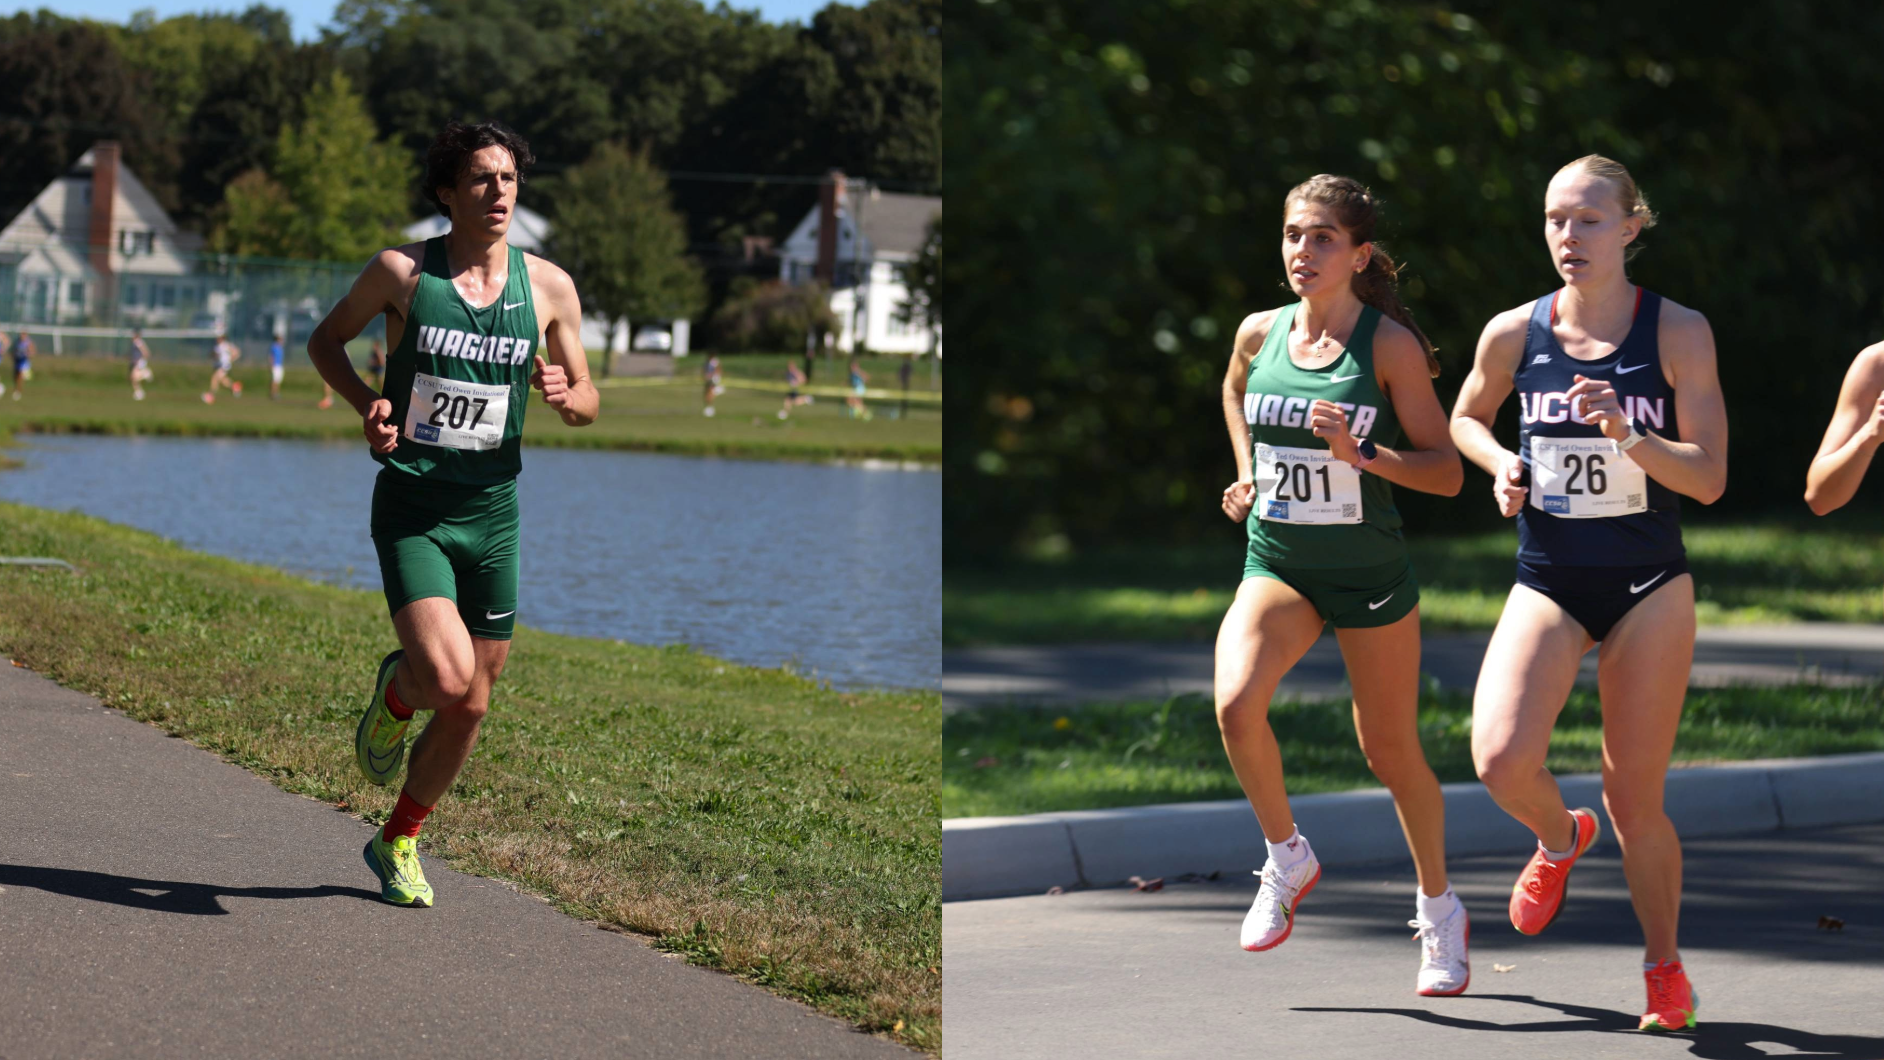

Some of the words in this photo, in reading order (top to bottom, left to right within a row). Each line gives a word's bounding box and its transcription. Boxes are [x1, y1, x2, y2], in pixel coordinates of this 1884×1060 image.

[417, 326, 530, 365] WAGNER
[417, 378, 438, 388] CCSU
[439, 384, 451, 392] Ted
[452, 387, 471, 395] Owen
[472, 389, 505, 397] Invitational
[428, 392, 489, 430] 207
[1555, 444, 1569, 452] Ted
[1570, 444, 1592, 452] Owen
[1275, 461, 1331, 503] 201
[1563, 453, 1607, 495] 26
